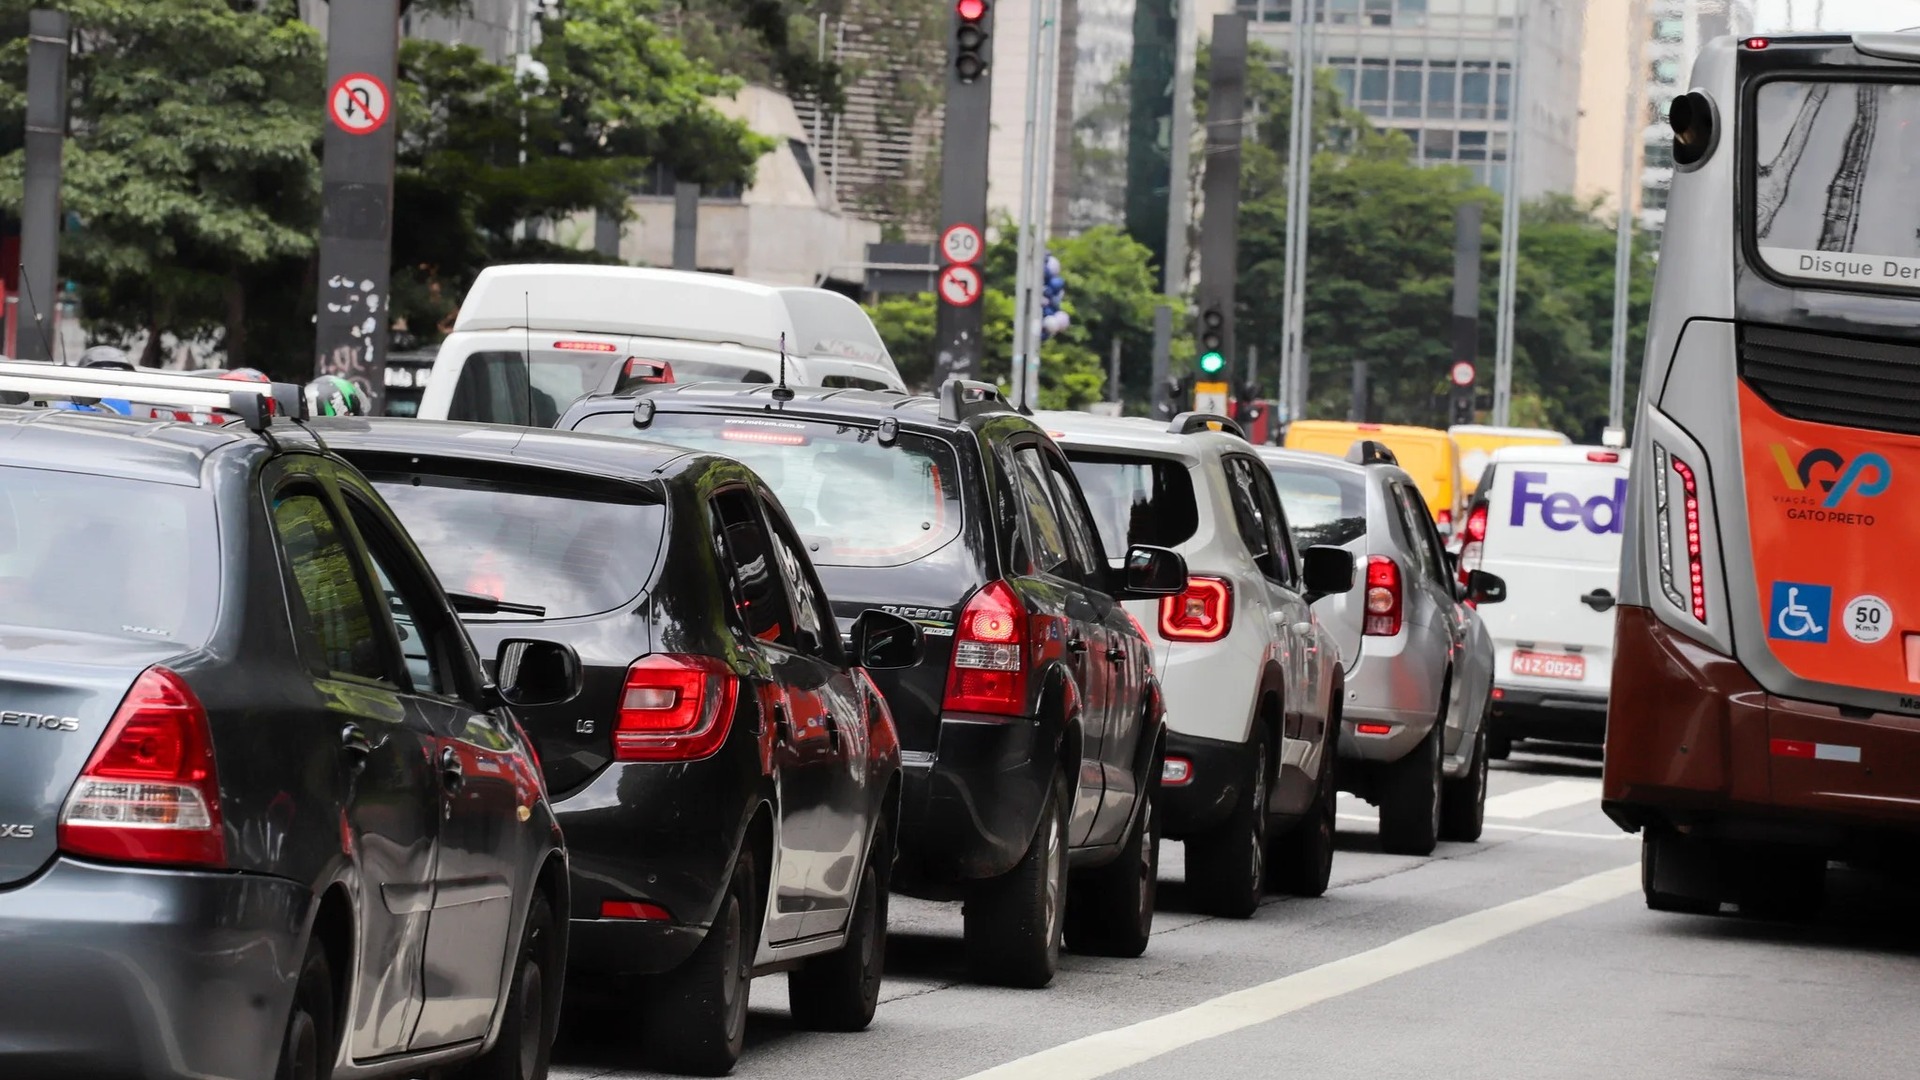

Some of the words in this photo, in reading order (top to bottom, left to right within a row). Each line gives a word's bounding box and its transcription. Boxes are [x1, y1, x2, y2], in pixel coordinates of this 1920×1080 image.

[949, 233, 974, 250] 50
[1799, 254, 1873, 278] Disque
[1509, 470, 1628, 534] Fed
[1786, 508, 1826, 522] GATO
[1828, 511, 1875, 526] PRETO
[881, 605, 953, 621] TUCSON
[1856, 606, 1881, 624] 50
[0, 710, 80, 732] ETIOS
[0, 823, 34, 838] XS
